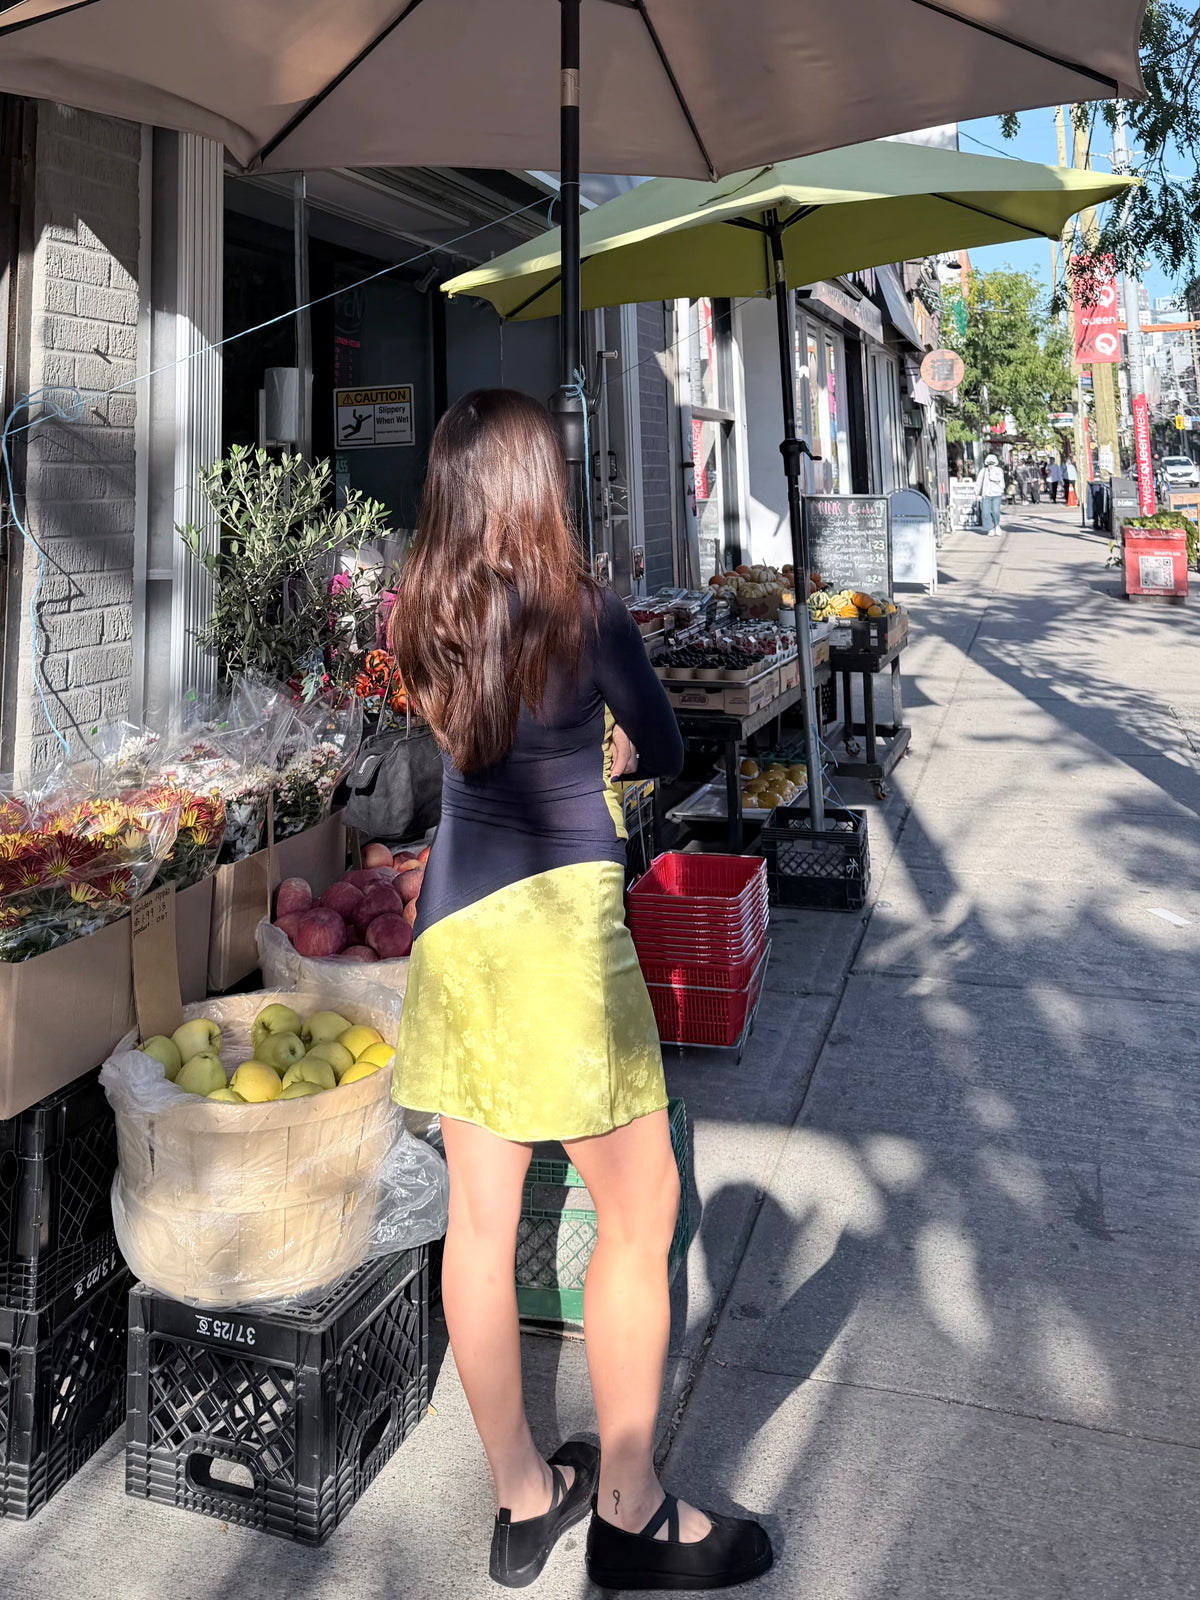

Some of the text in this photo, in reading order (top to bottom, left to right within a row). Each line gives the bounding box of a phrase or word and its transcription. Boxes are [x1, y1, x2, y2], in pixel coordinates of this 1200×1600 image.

[354, 390, 406, 404] CAUTION
[378, 406, 406, 415] Slippery
[376, 415, 409, 425] When Wet
[213, 1319, 256, 1345] 37/25
